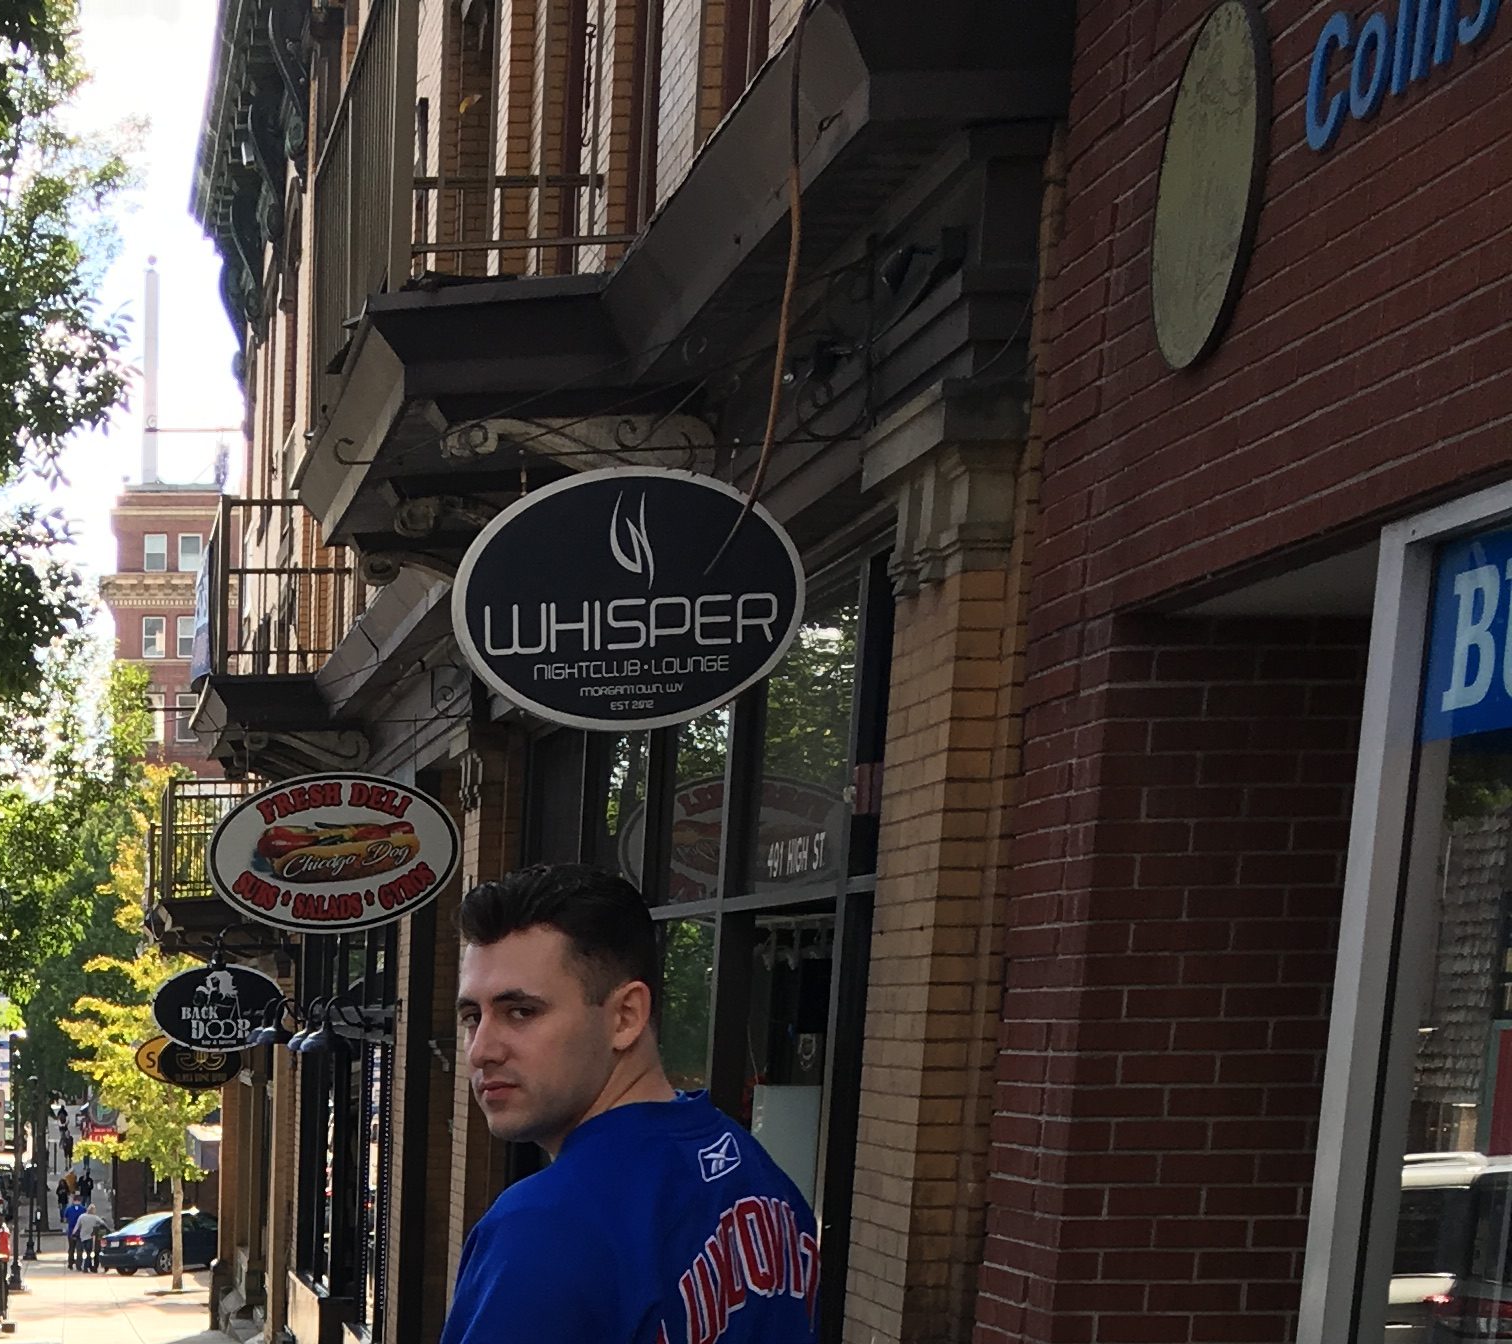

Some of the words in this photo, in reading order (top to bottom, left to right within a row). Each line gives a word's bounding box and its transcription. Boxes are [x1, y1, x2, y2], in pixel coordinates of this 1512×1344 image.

[484, 593, 778, 656] WHISPER
[533, 658, 641, 681] NIGHTCLUB
[651, 655, 730, 675] LOUNGE
[256, 782, 343, 825] FRESH
[348, 782, 414, 819] DELI
[282, 855, 356, 879] Chicago
[361, 840, 410, 866] Dog
[232, 870, 281, 912] SUBS
[291, 892, 364, 921] SALADS
[378, 861, 437, 910] GYROS
[181, 1006, 218, 1020] BACK
[191, 1019, 251, 1039] DOOR
